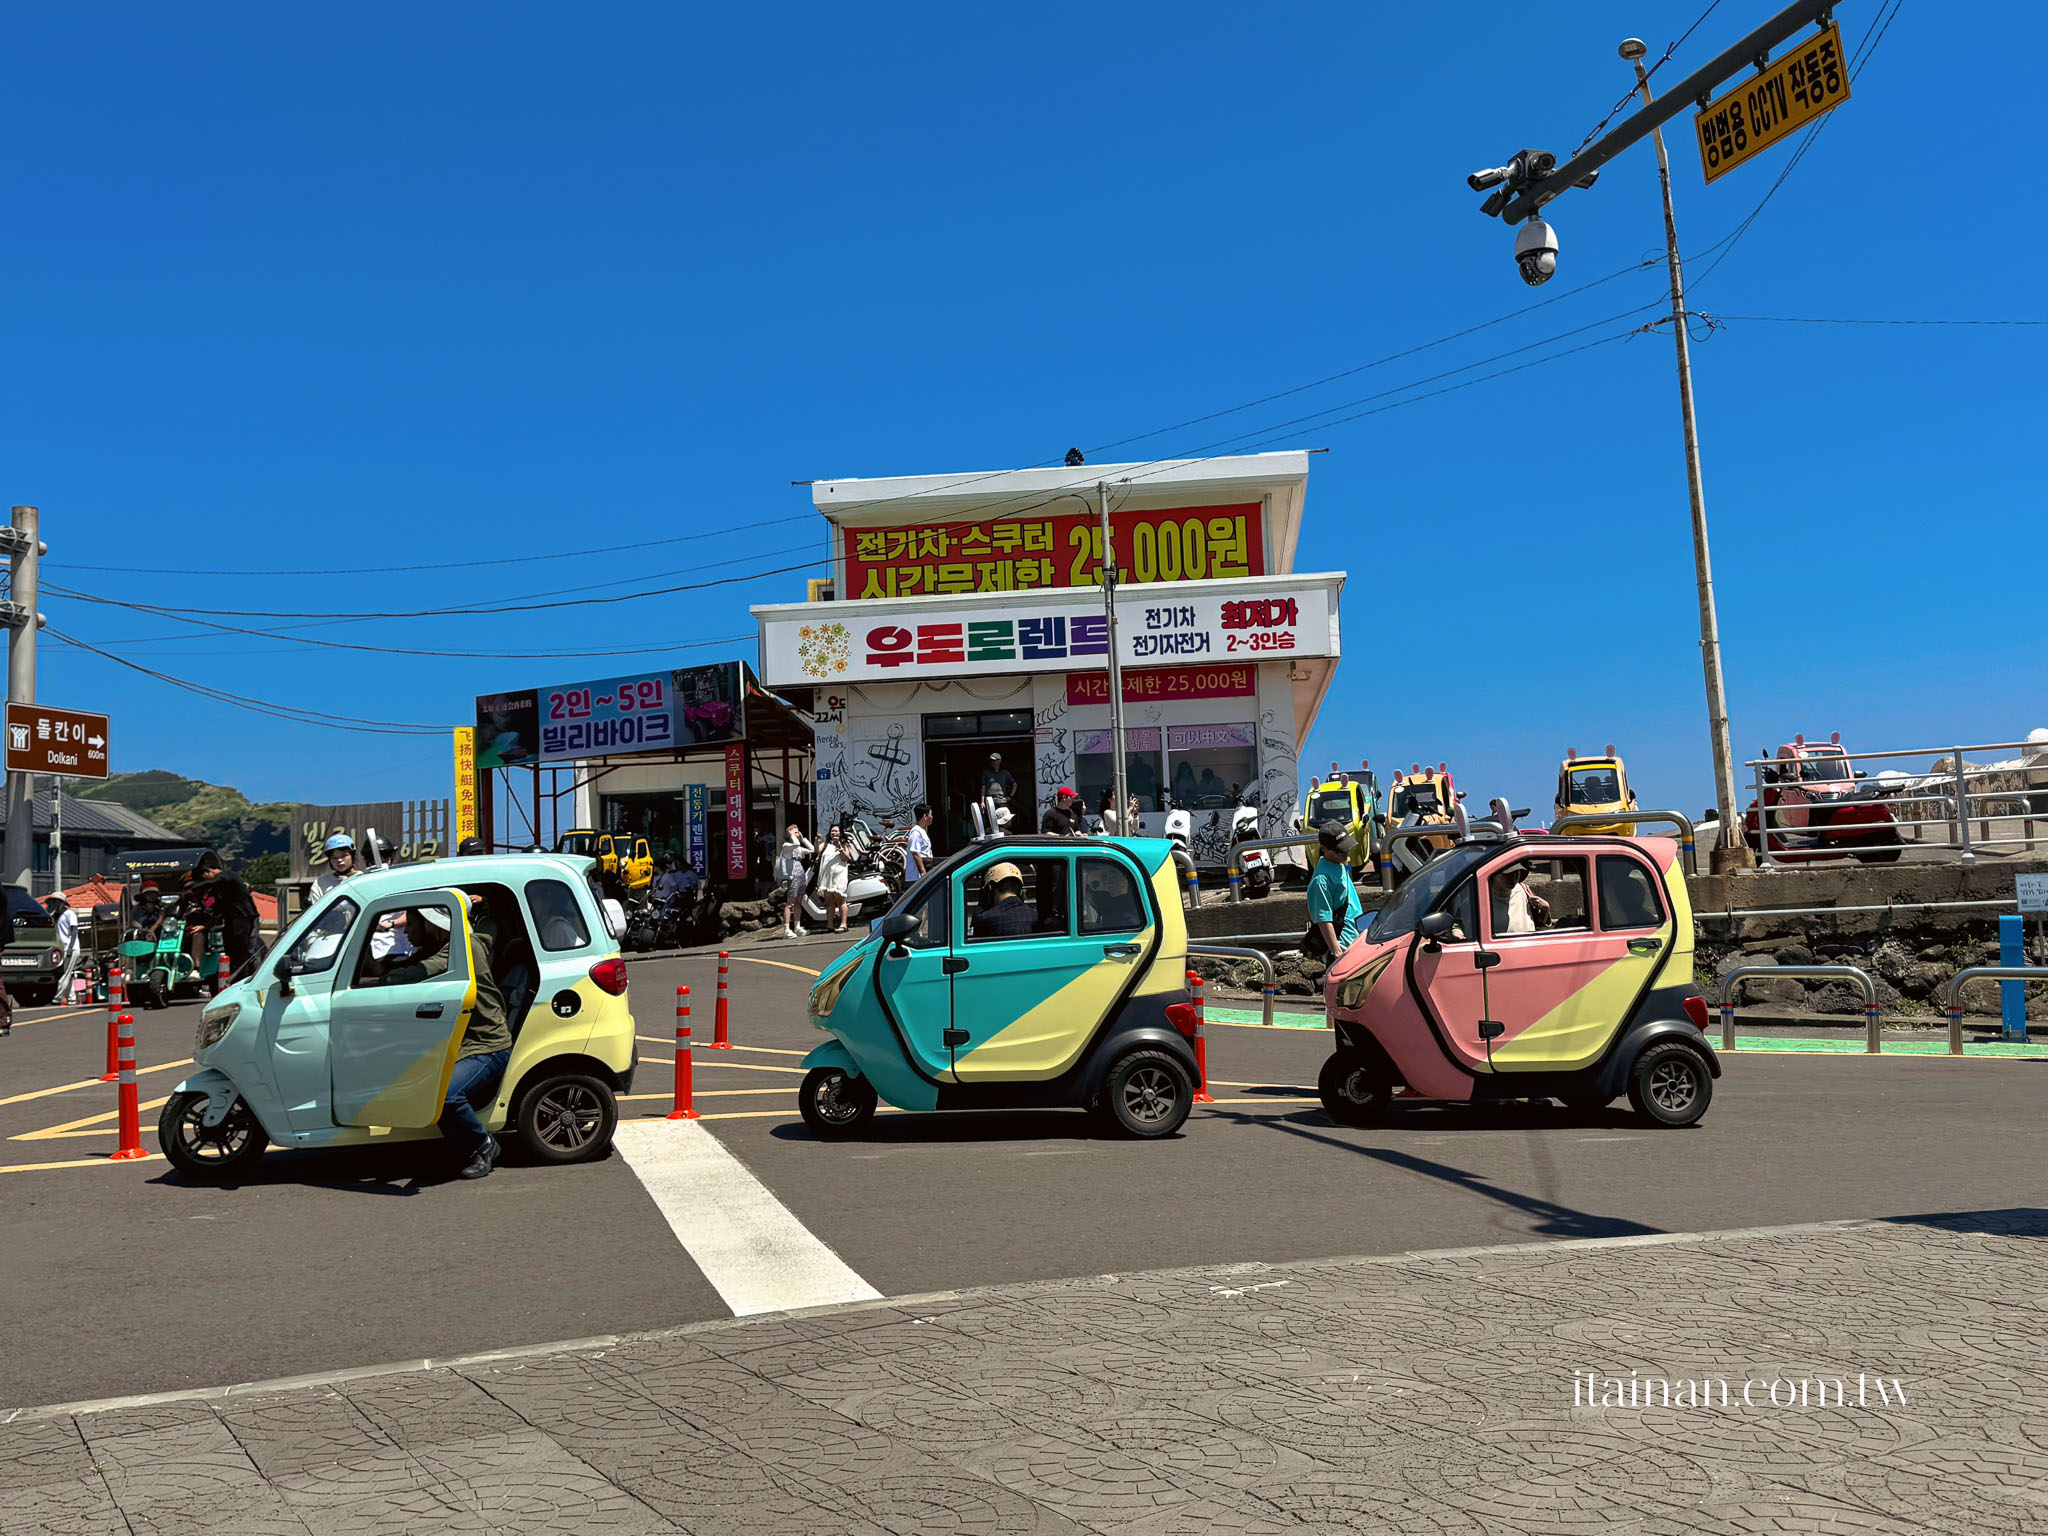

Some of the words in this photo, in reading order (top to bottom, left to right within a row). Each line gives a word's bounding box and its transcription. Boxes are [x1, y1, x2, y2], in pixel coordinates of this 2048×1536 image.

[1701, 101, 1747, 168] 방범용
[1747, 72, 1789, 137] CCTV
[1787, 39, 1841, 109] 작동중
[1145, 606, 1196, 629] 전기차
[1220, 598, 1299, 629] 최저가
[866, 615, 1108, 668] 우도로렌트
[1132, 631, 1211, 656] 전기자전거
[1226, 631, 1296, 652] 2~3인승
[1074, 675, 1161, 697] 시간제한
[1167, 669, 1248, 693] 25,000원
[542, 713, 671, 754] 빌리바이크
[1174, 729, 1230, 745] 可以中文
[47, 750, 79, 766] Dolkani
[87, 749, 105, 760] 600m
[729, 749, 741, 791] 스쿠터
[458, 730, 475, 840] 飞扬快艇免费接
[729, 794, 742, 822] 대여
[692, 823, 704, 846] 렌트
